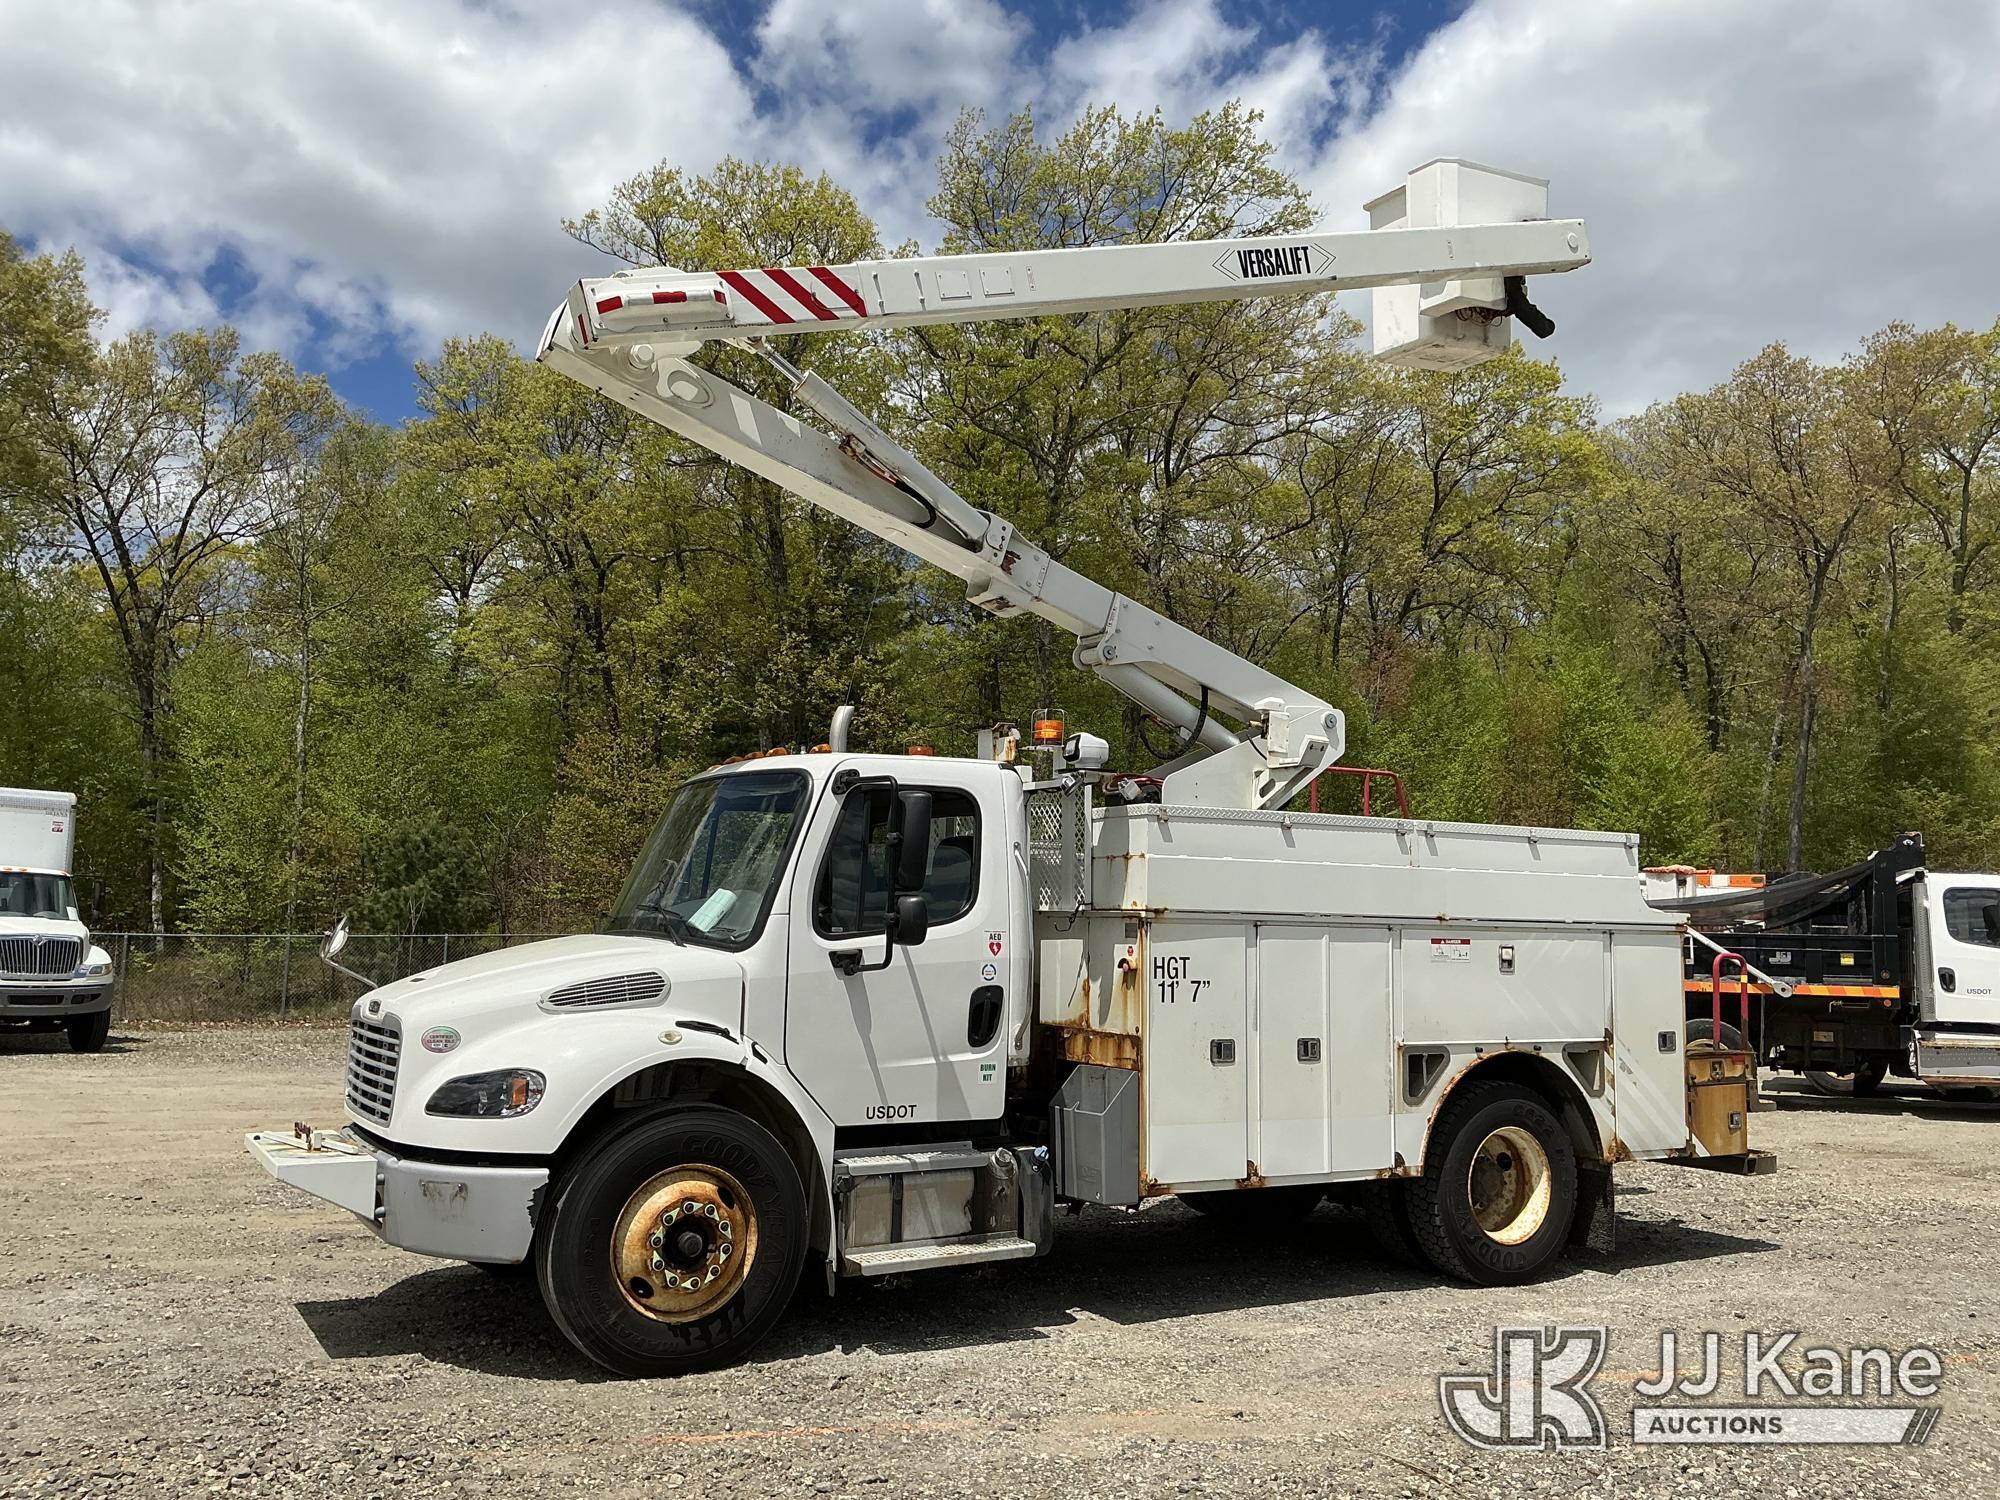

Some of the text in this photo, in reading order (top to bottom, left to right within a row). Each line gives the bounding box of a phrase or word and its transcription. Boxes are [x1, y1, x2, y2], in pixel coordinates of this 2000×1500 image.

[1237, 246, 1312, 279] VERSALIFT
[1153, 956, 1190, 980] HGT
[866, 1105, 917, 1119] USDOT
